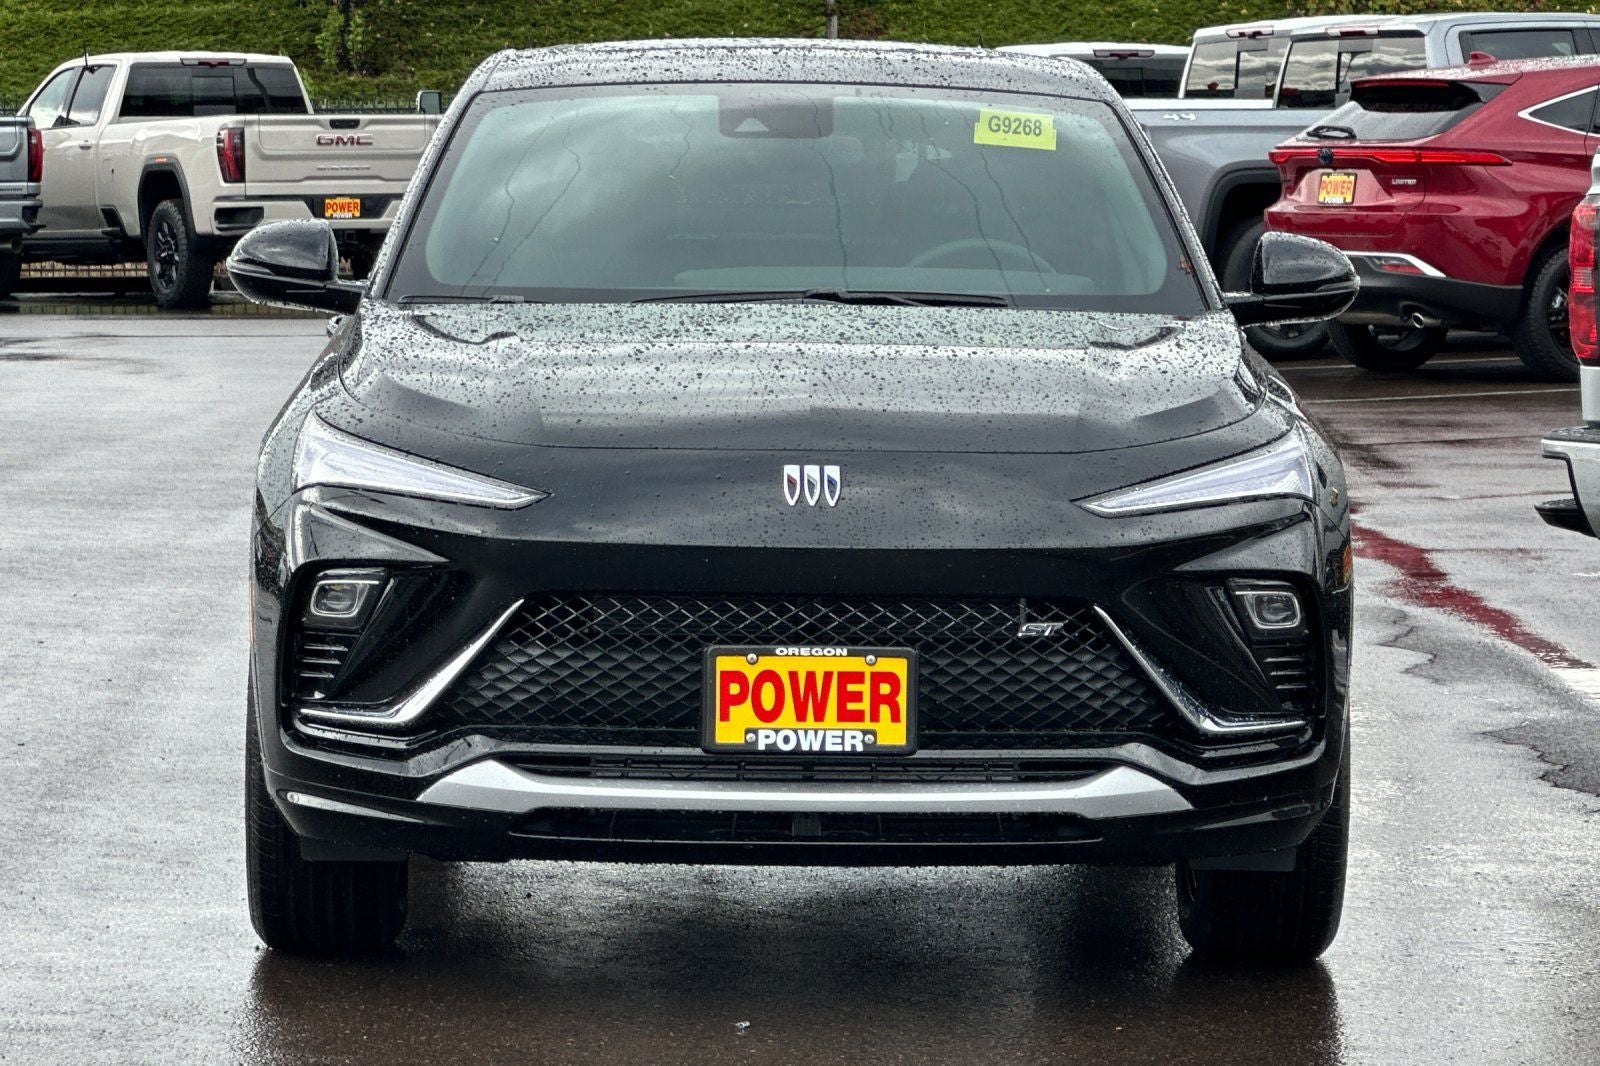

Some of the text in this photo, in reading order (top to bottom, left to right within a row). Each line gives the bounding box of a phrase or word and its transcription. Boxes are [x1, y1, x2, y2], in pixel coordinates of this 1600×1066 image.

[988, 115, 1042, 136] G9268
[316, 133, 373, 146] GMC
[1320, 180, 1352, 195] POWER
[326, 201, 360, 213] POWER
[1017, 622, 1064, 637] ST
[775, 647, 848, 657] OREGON
[719, 669, 901, 724] POWER
[757, 729, 864, 752] POWER
